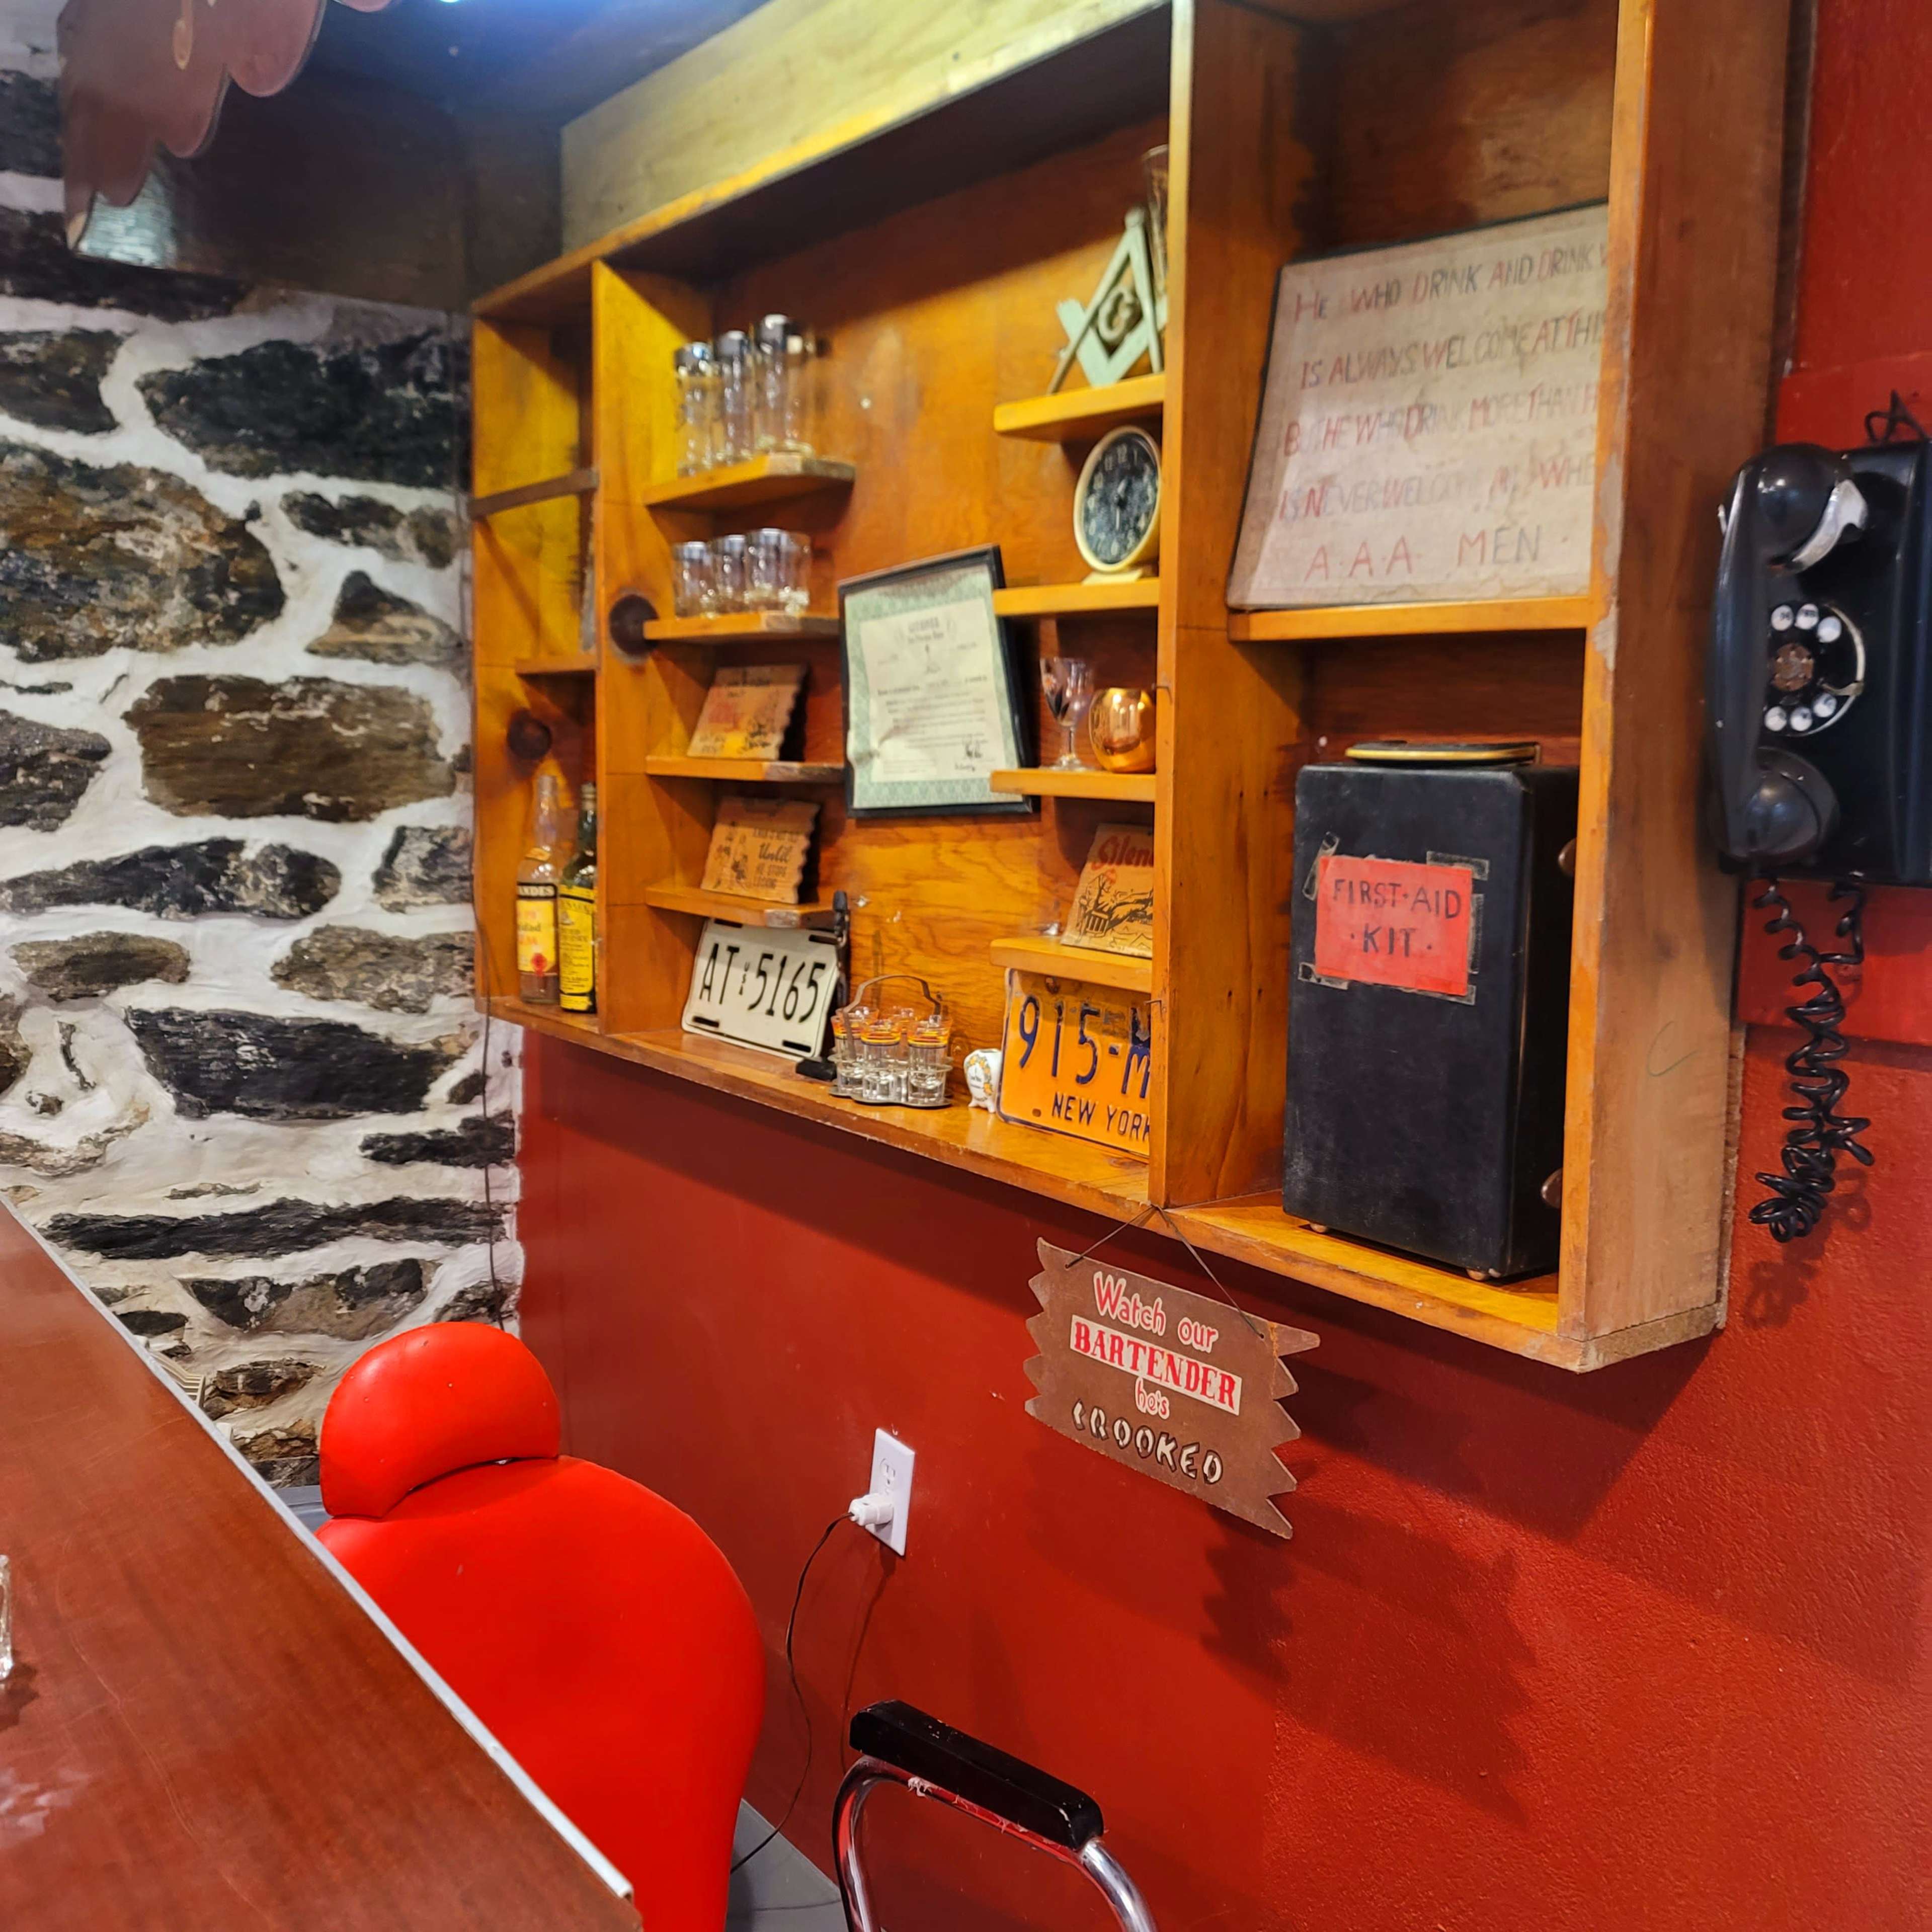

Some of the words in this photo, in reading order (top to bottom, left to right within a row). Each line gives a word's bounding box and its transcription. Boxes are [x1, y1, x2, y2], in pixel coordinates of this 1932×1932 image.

[1295, 291, 1329, 323] HE
[1351, 278, 1402, 313] WHO
[1412, 264, 1483, 304] DRINK
[1488, 254, 1534, 290] AND
[1537, 244, 1594, 282] DRINK
[1300, 358, 1322, 390] IS
[1328, 341, 1418, 385] ALWAYS
[1565, 305, 1606, 349] THI
[1457, 525, 1541, 567] MEN
[747, 953, 827, 1024] 5165
[1052, 1092, 1096, 1126] NEW
[1093, 1271, 1166, 1336] Watch
[1177, 1317, 1219, 1353] our
[1073, 1321, 1237, 1411] BARTENDER
[1135, 1377, 1170, 1420] he's
[1072, 1399, 1224, 1484] CROOKED
